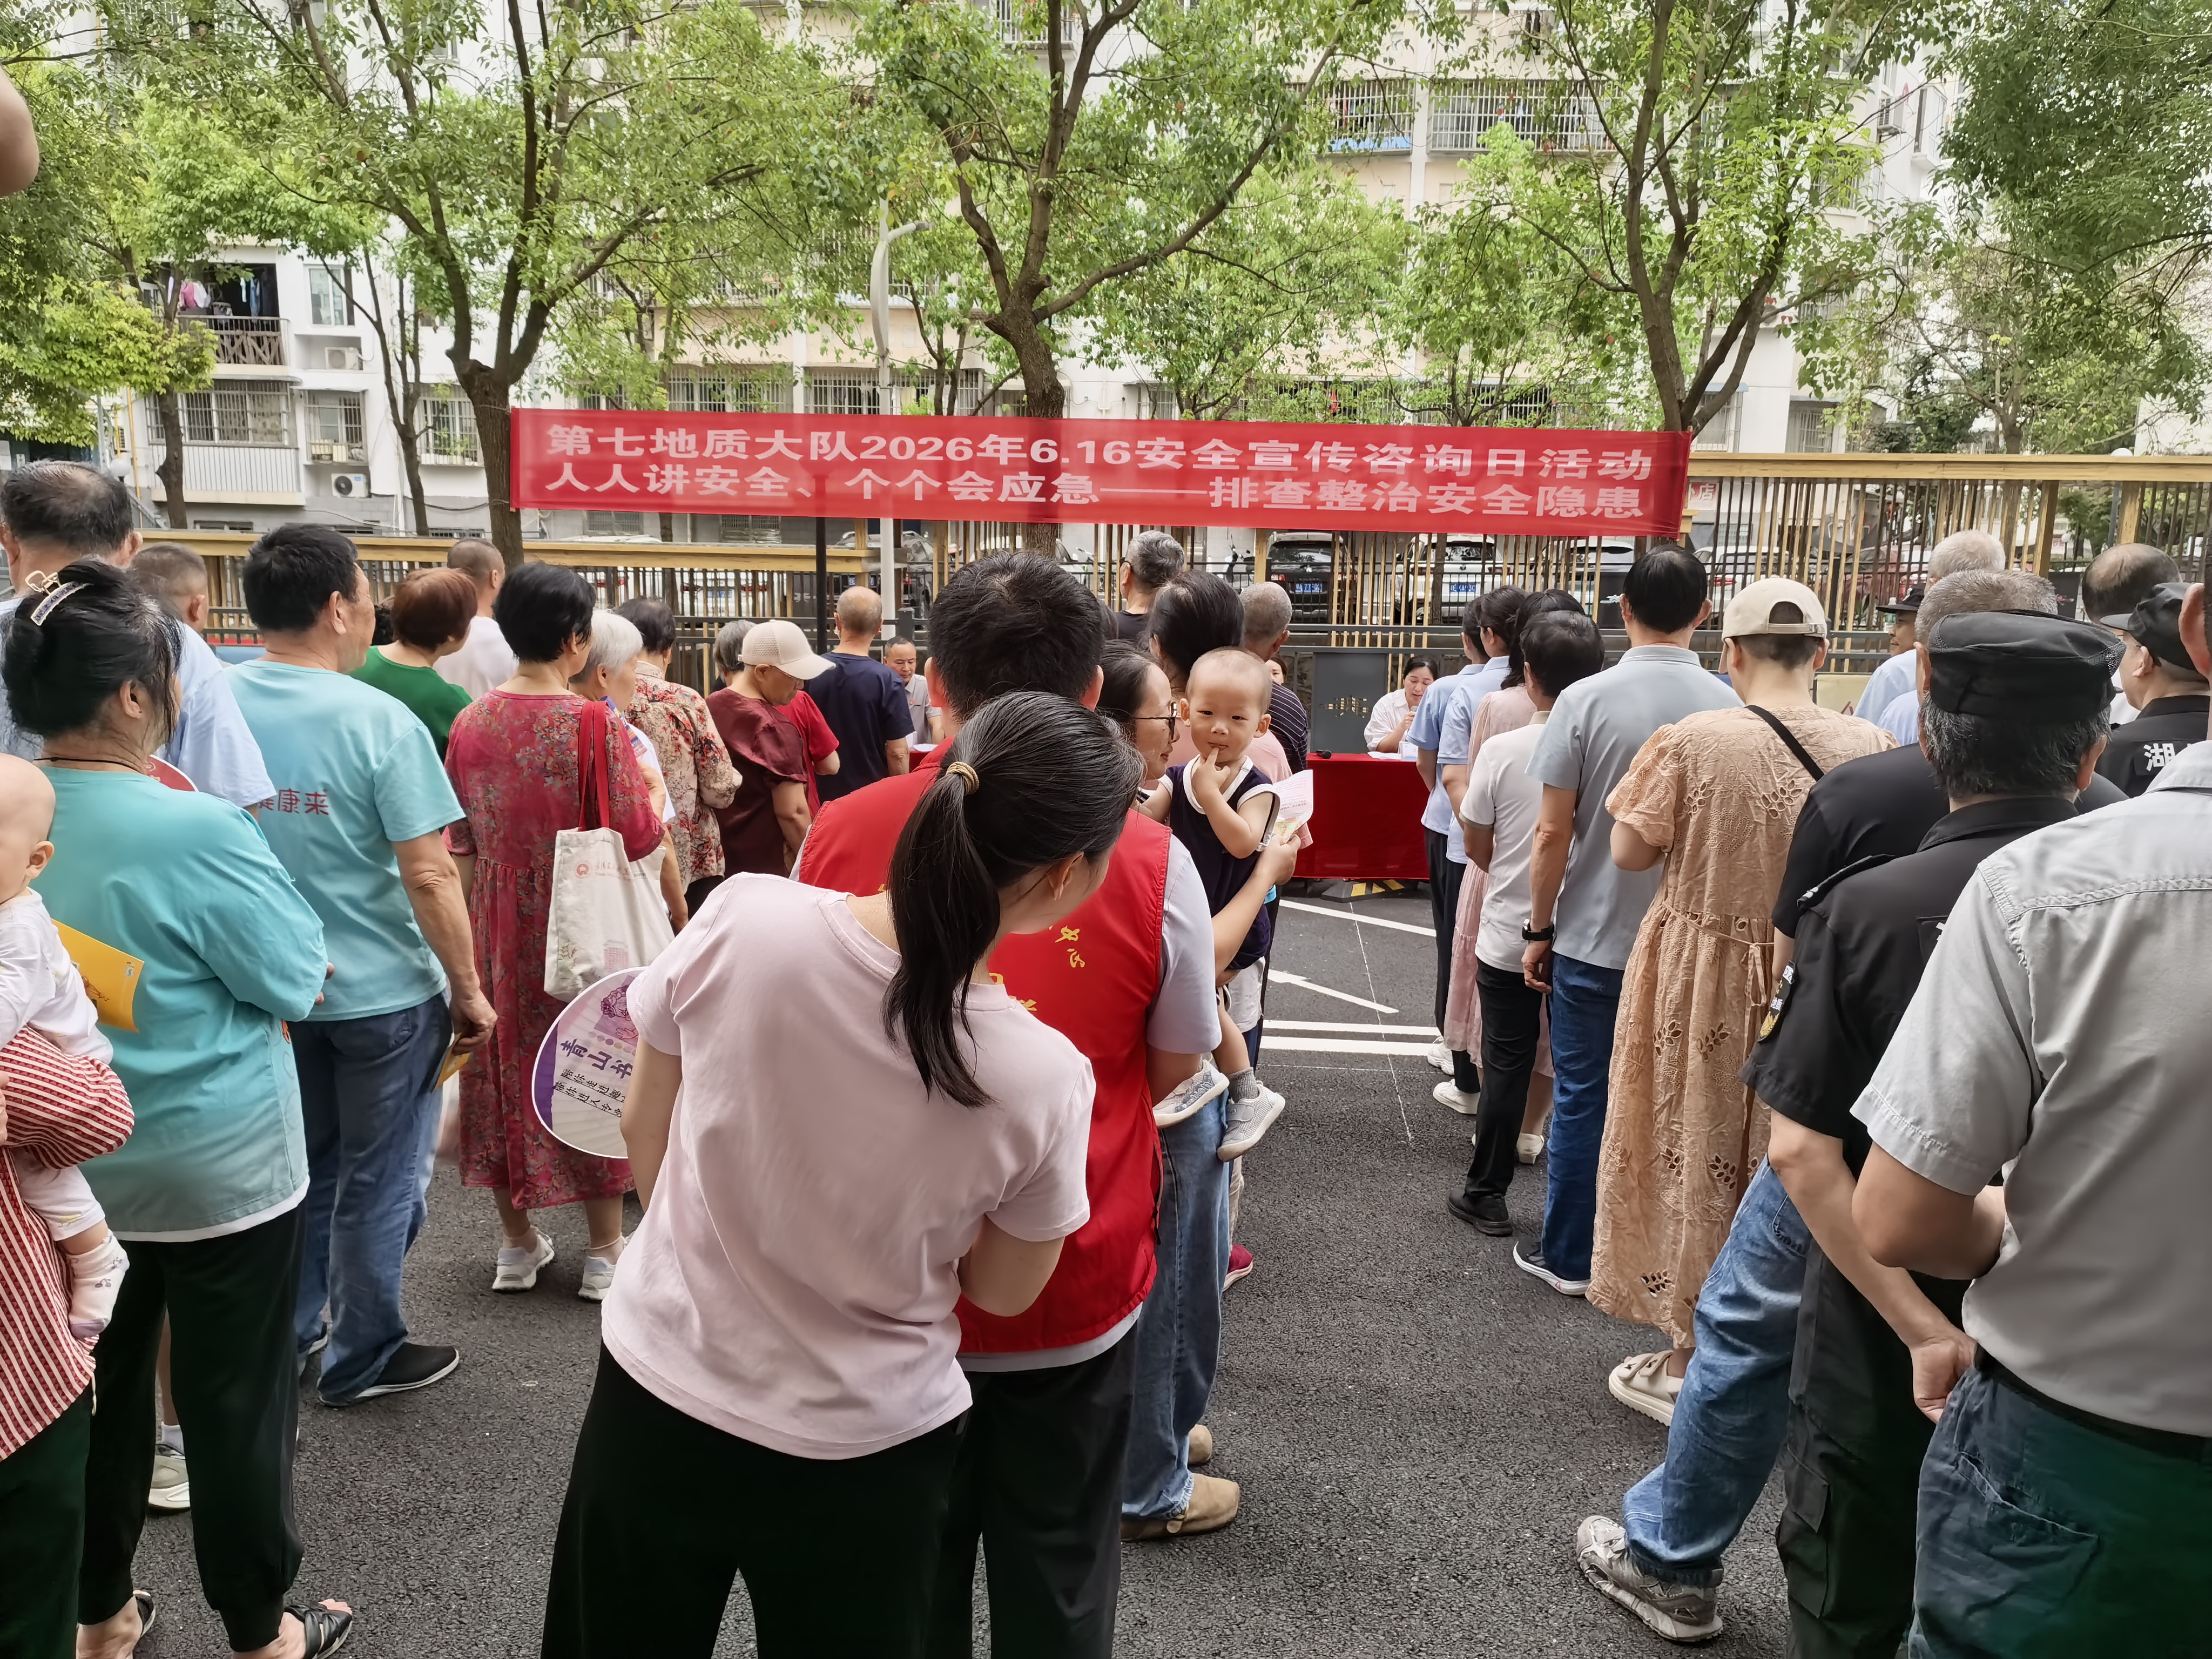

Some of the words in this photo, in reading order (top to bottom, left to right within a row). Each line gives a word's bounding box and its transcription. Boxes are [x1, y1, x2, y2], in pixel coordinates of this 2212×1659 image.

[546, 424, 1651, 480] 第七地质大队2026年6.16安全宣传咨询日活动
[545, 462, 1643, 518] 人人讲安全、个个会应急——排查整治安全隐患
[2143, 743, 2192, 771] 湖
